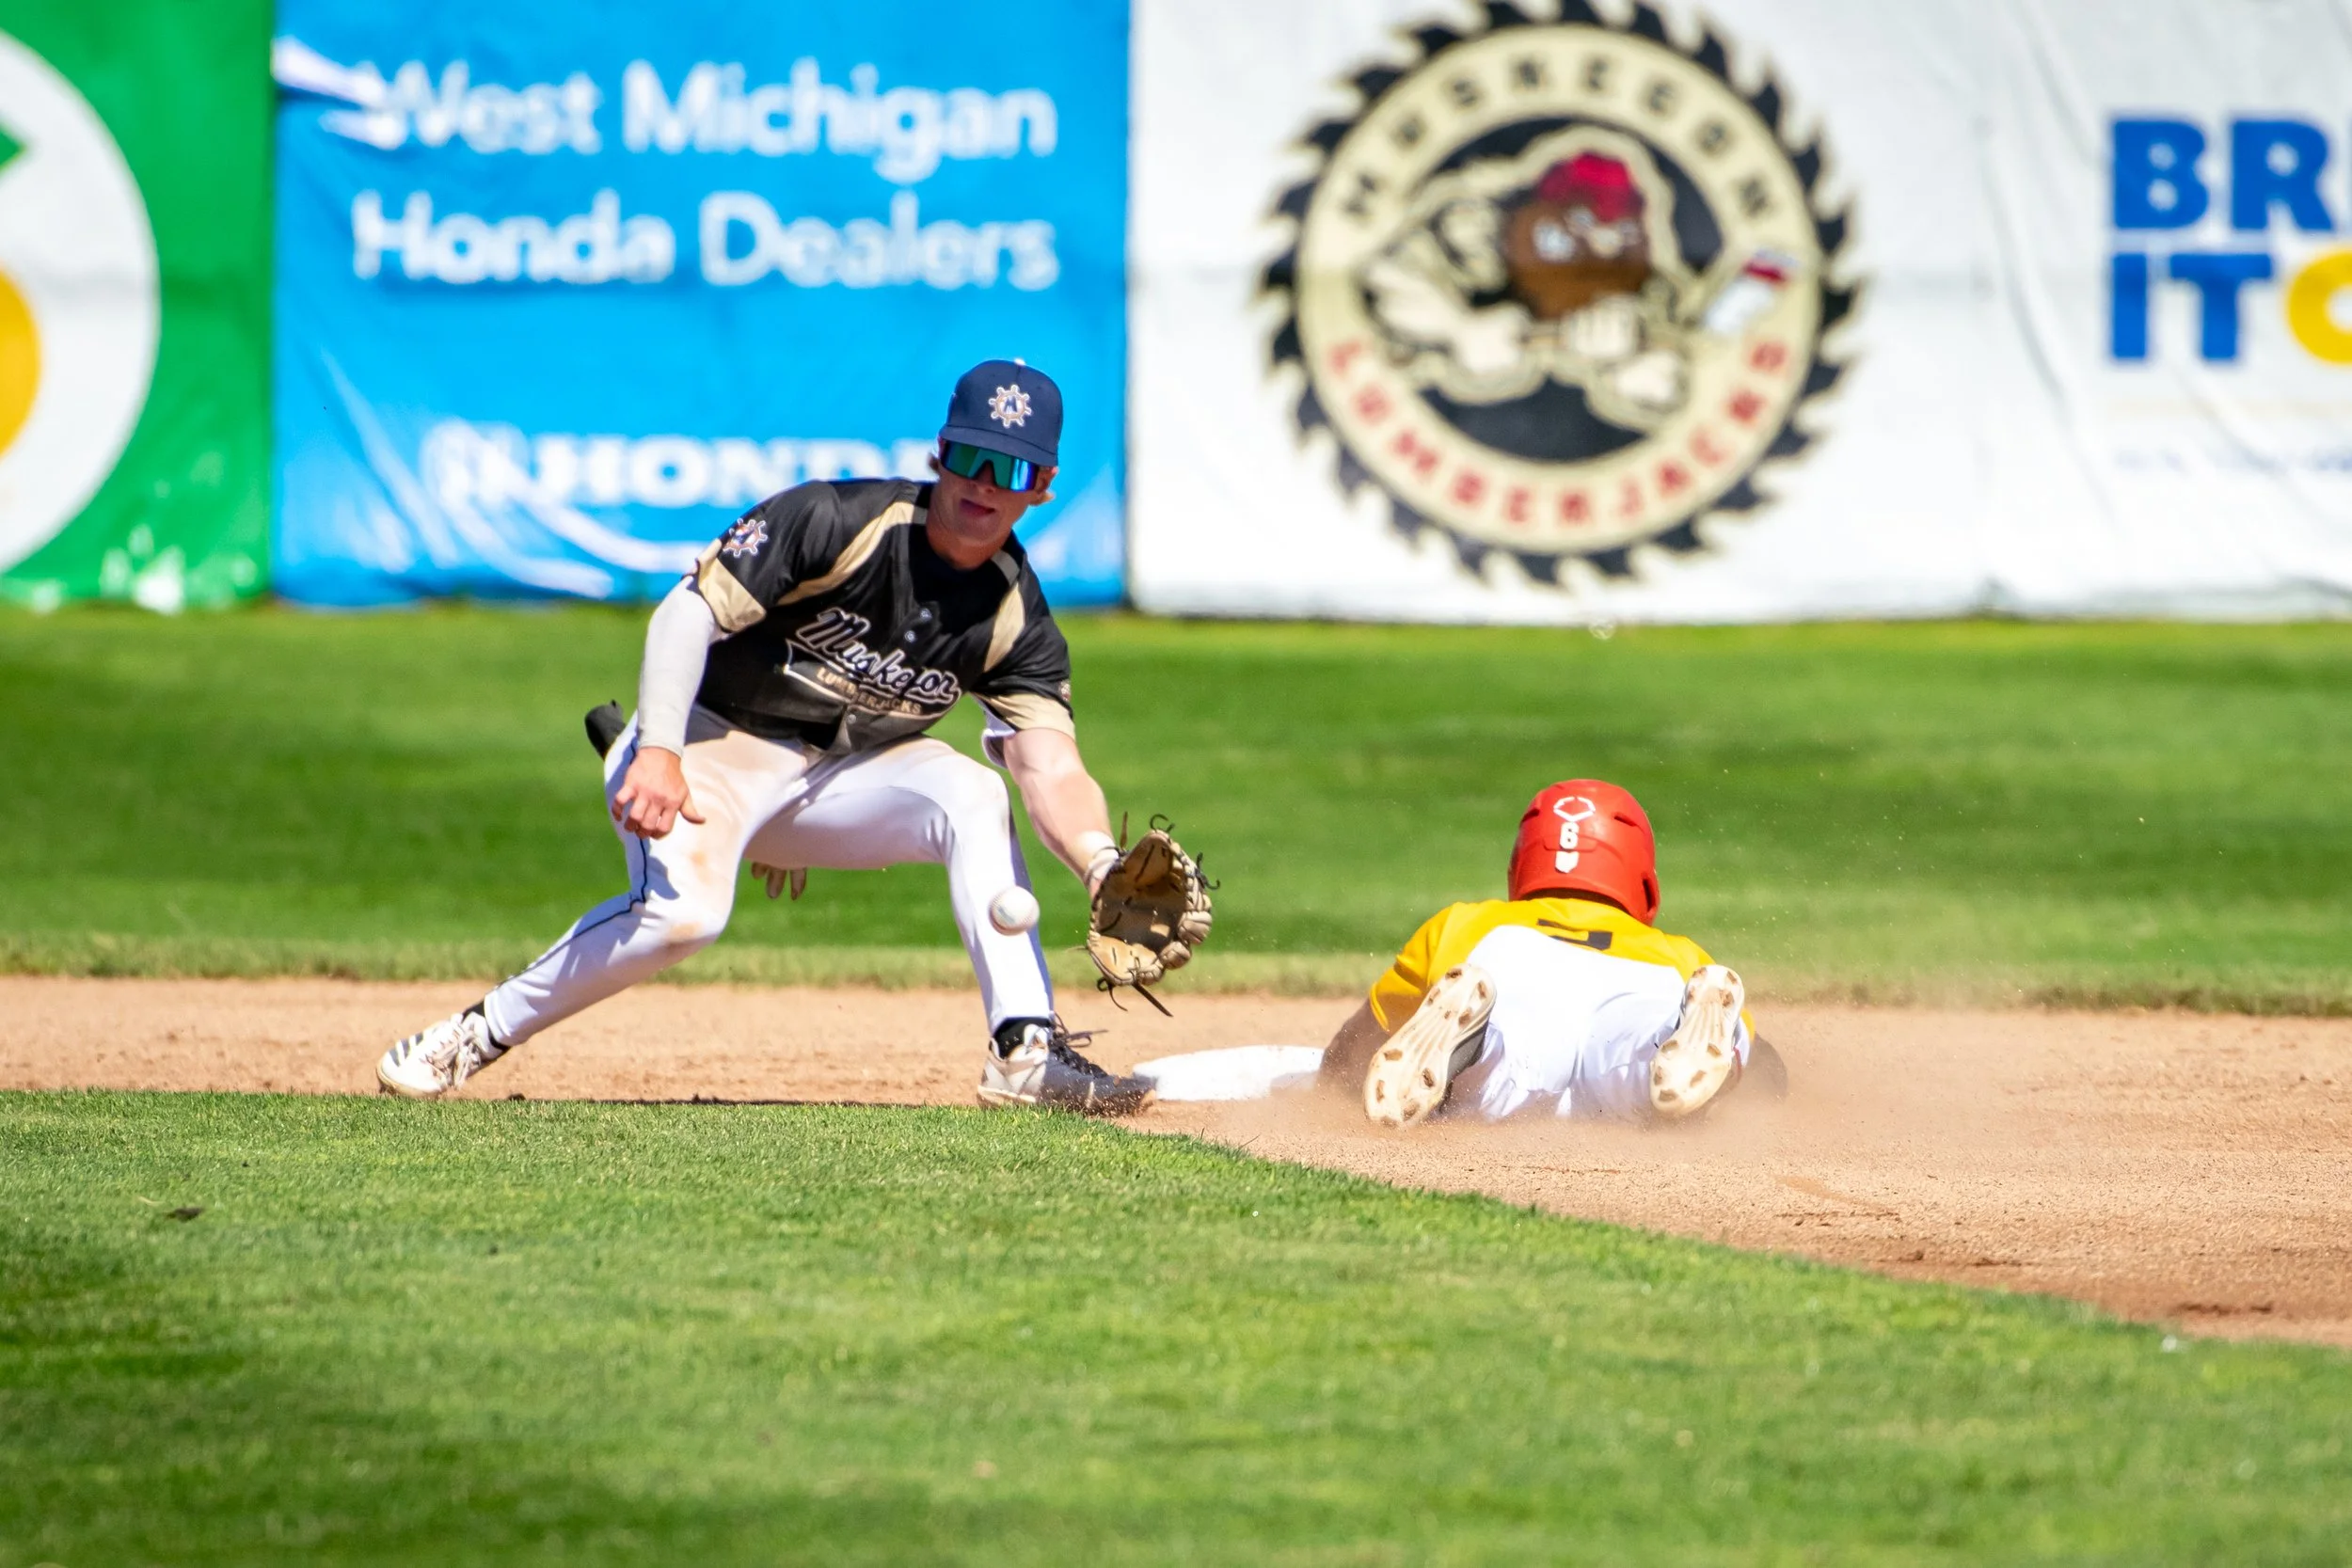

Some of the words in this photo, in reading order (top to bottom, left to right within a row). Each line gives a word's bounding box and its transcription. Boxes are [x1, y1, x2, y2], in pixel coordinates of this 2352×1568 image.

[353, 59, 603, 155] West
[621, 57, 1060, 184] Michigan
[2111, 119, 2352, 231] BR
[351, 187, 677, 284] Honda
[698, 188, 1061, 291] Dealers
